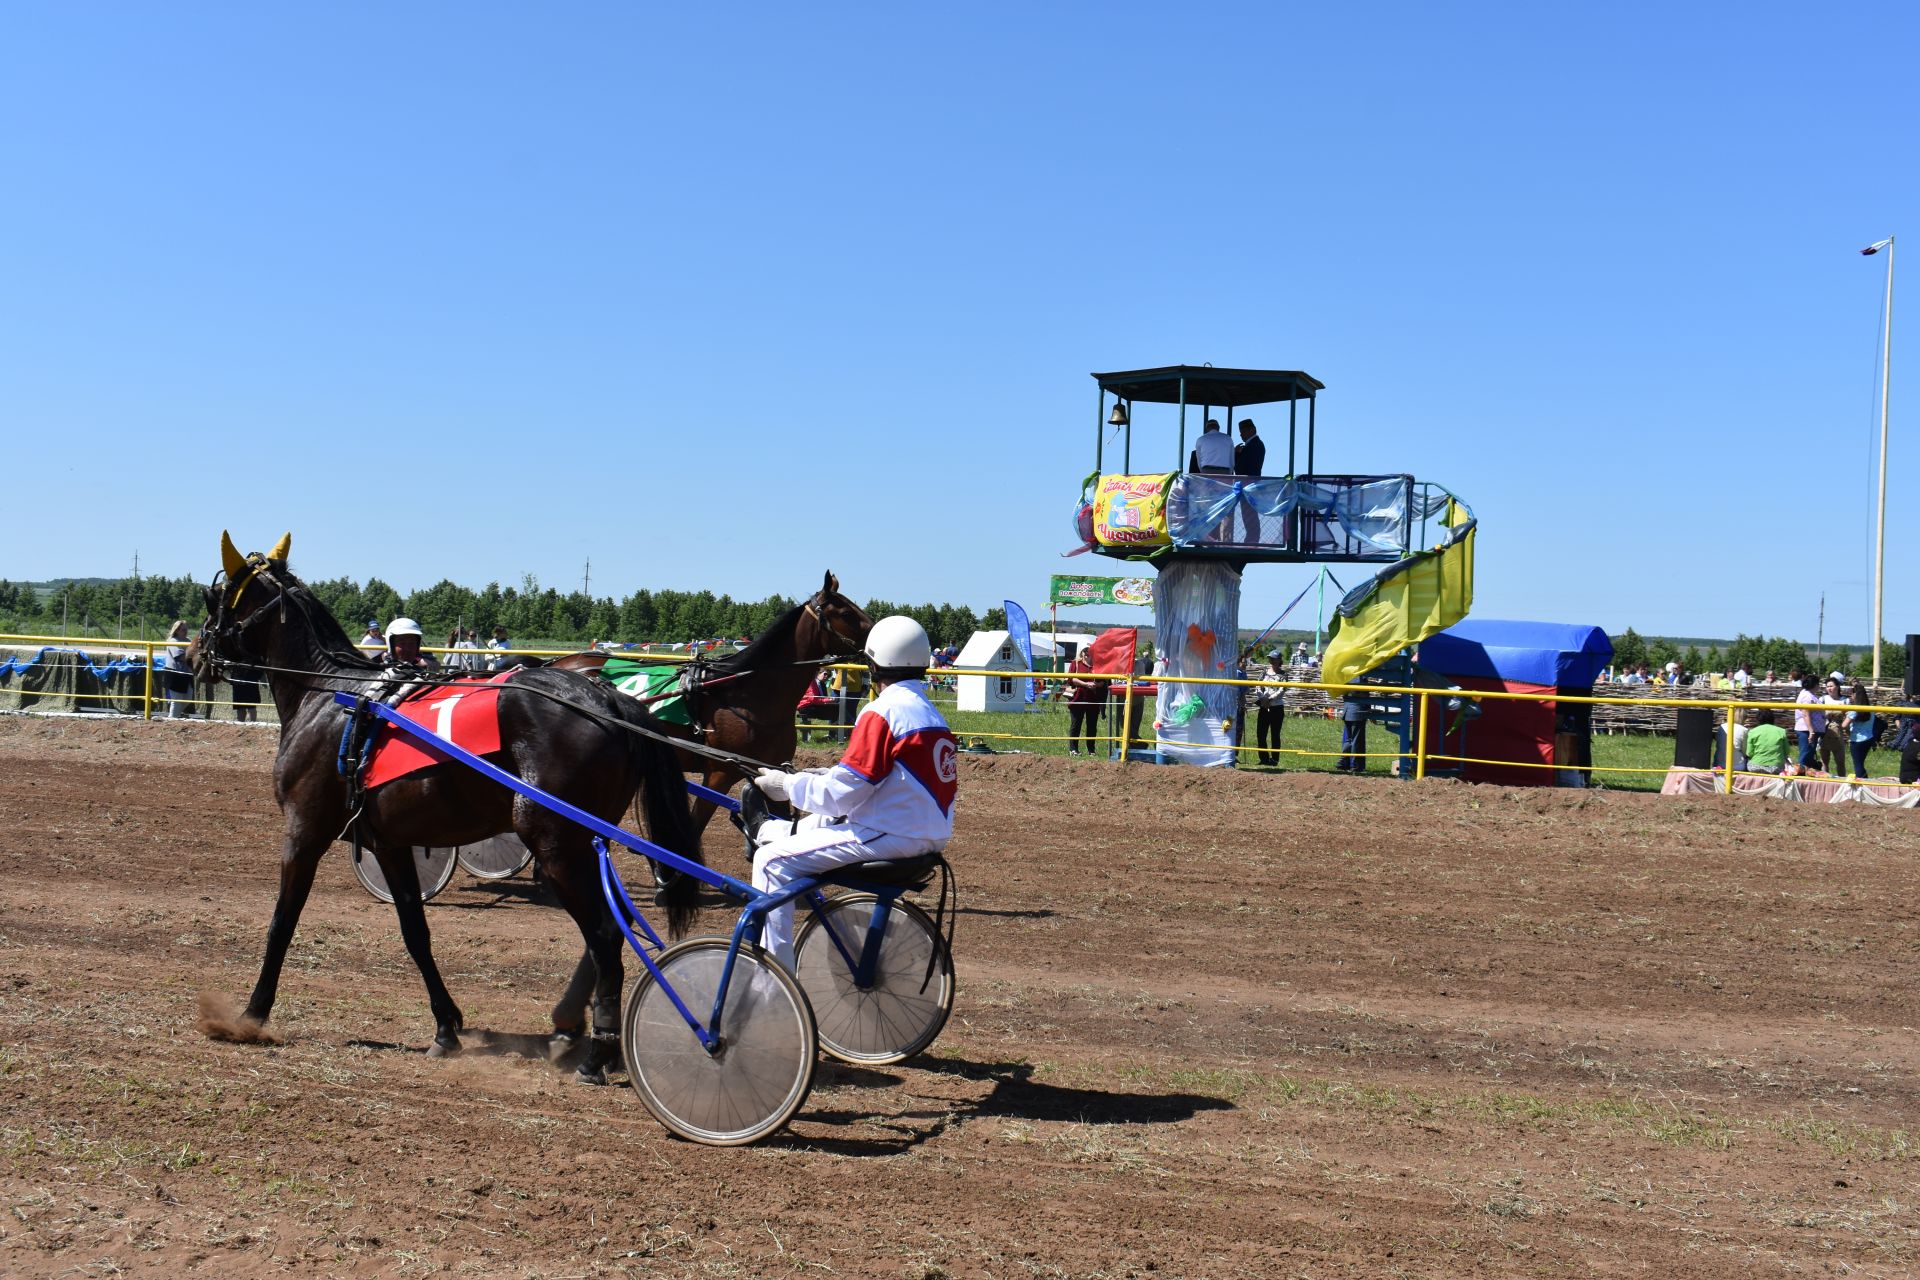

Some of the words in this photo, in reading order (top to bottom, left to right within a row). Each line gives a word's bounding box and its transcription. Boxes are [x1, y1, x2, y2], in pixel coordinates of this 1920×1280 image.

[1098, 523, 1157, 542] Чистай
[1070, 582, 1094, 591] Добро
[616, 671, 649, 702] 4
[429, 693, 464, 742] 1
